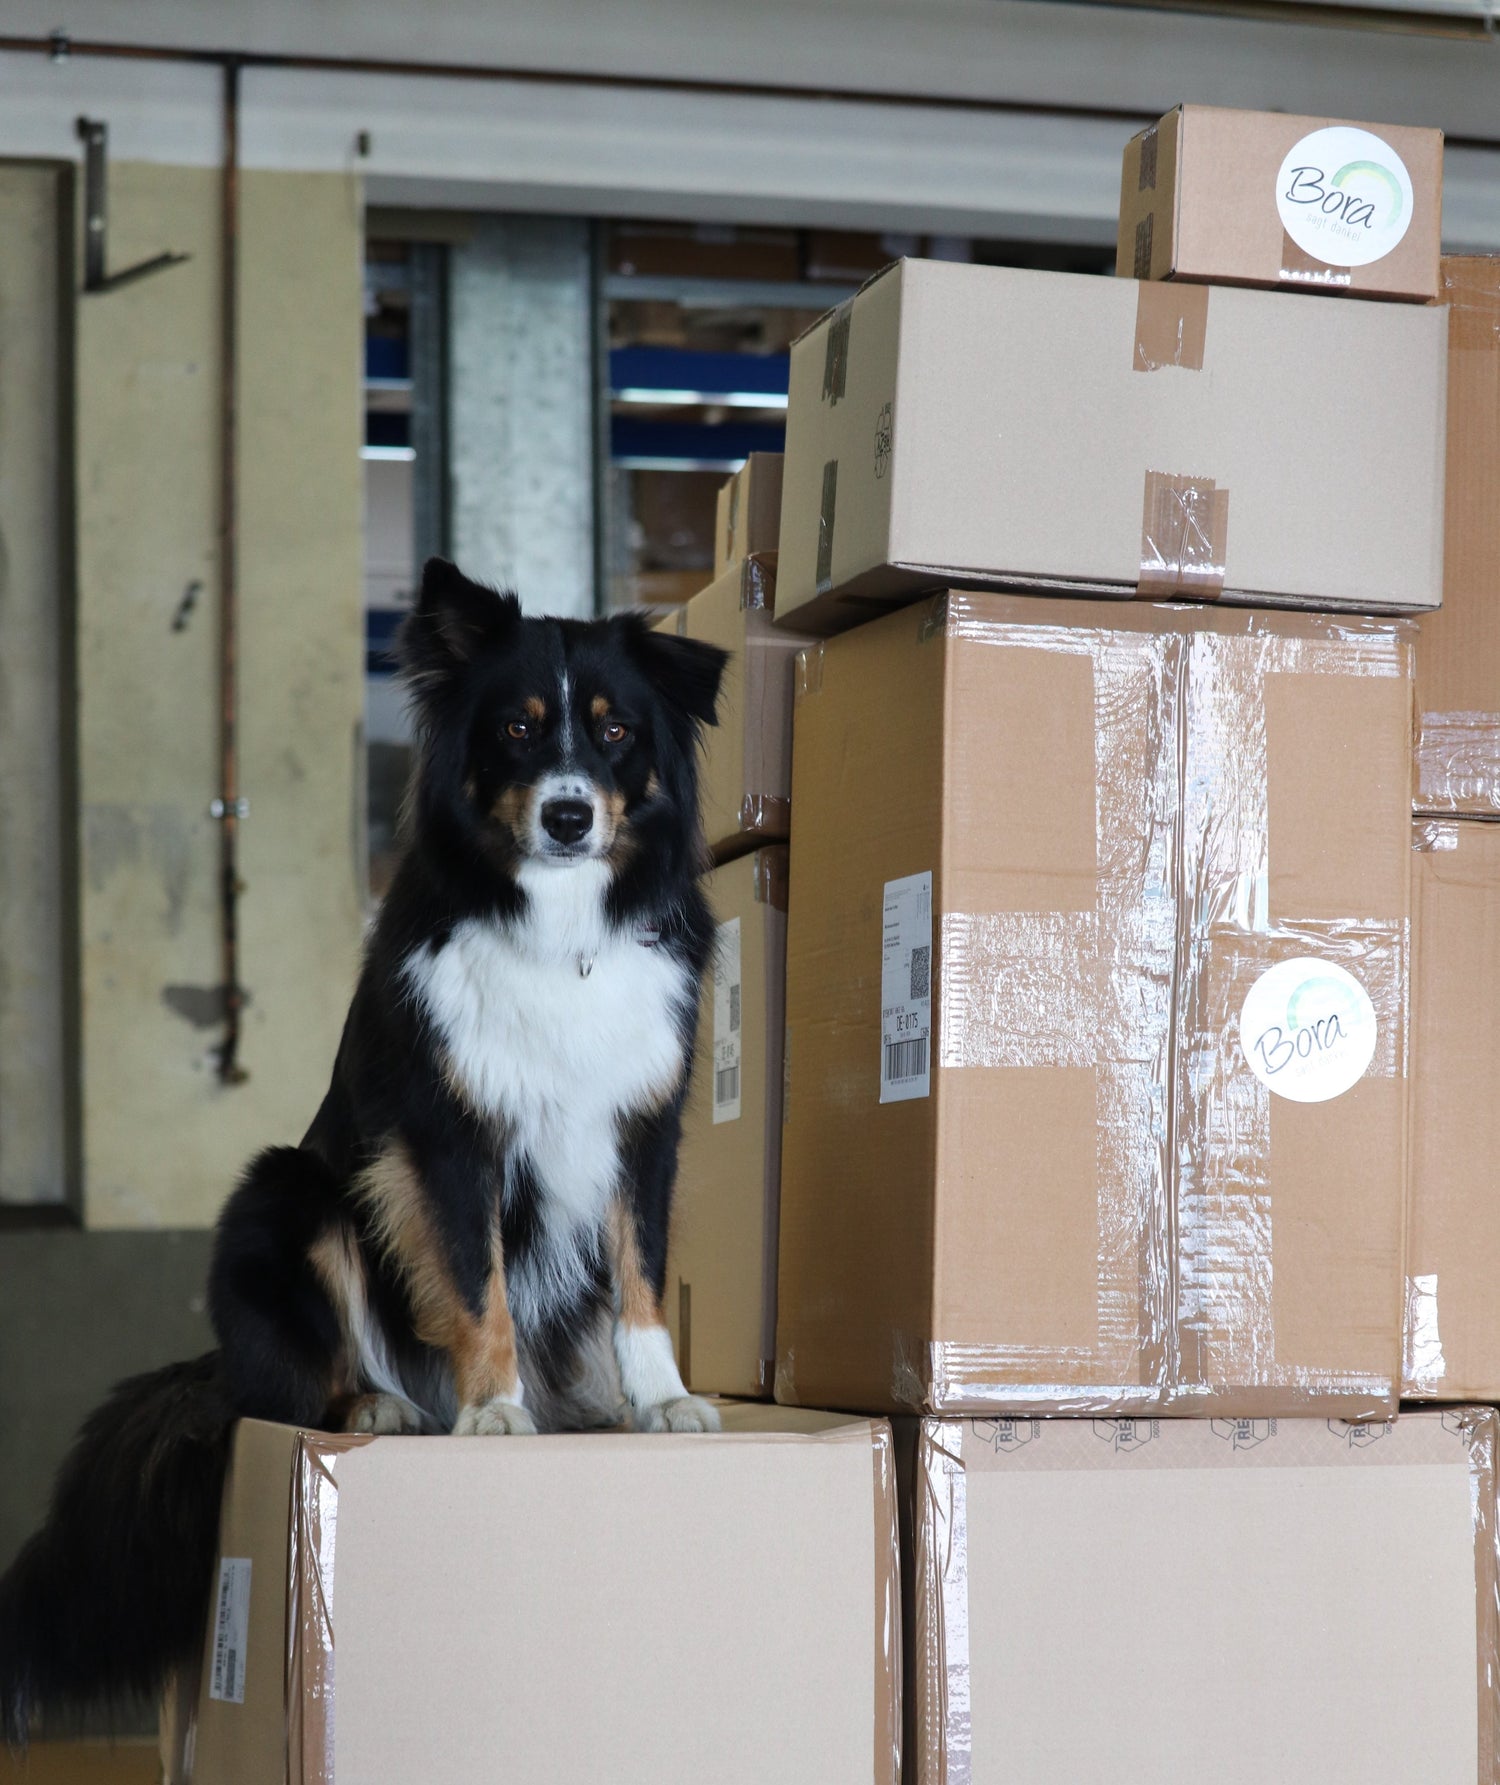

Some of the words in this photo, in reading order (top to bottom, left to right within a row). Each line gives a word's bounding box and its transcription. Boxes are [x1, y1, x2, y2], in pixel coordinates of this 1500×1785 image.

[1286, 167, 1375, 229] Bora
[1306, 213, 1328, 231] sagt
[1254, 1014, 1347, 1074] Bora
